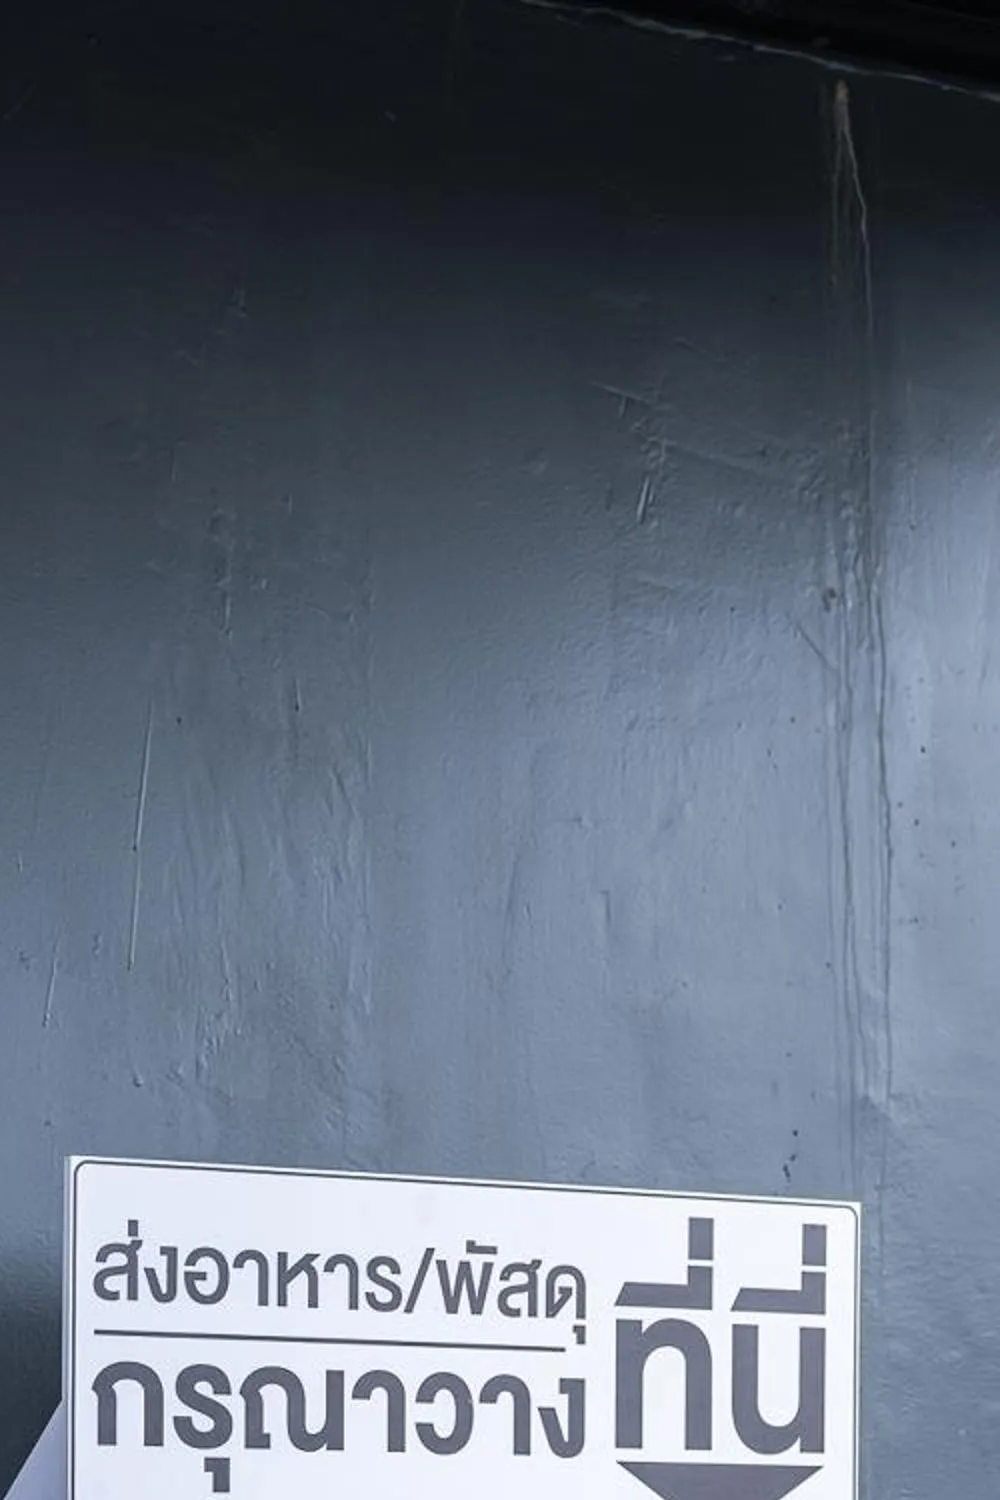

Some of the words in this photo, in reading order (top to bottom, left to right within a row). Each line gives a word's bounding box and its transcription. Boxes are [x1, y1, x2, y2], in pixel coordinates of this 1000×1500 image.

[92, 1219, 588, 1345] ส่งอาหาร/พัสดุ
[614, 1216, 828, 1456] ที่นี่
[91, 1360, 587, 1494] กรุณาวาง
